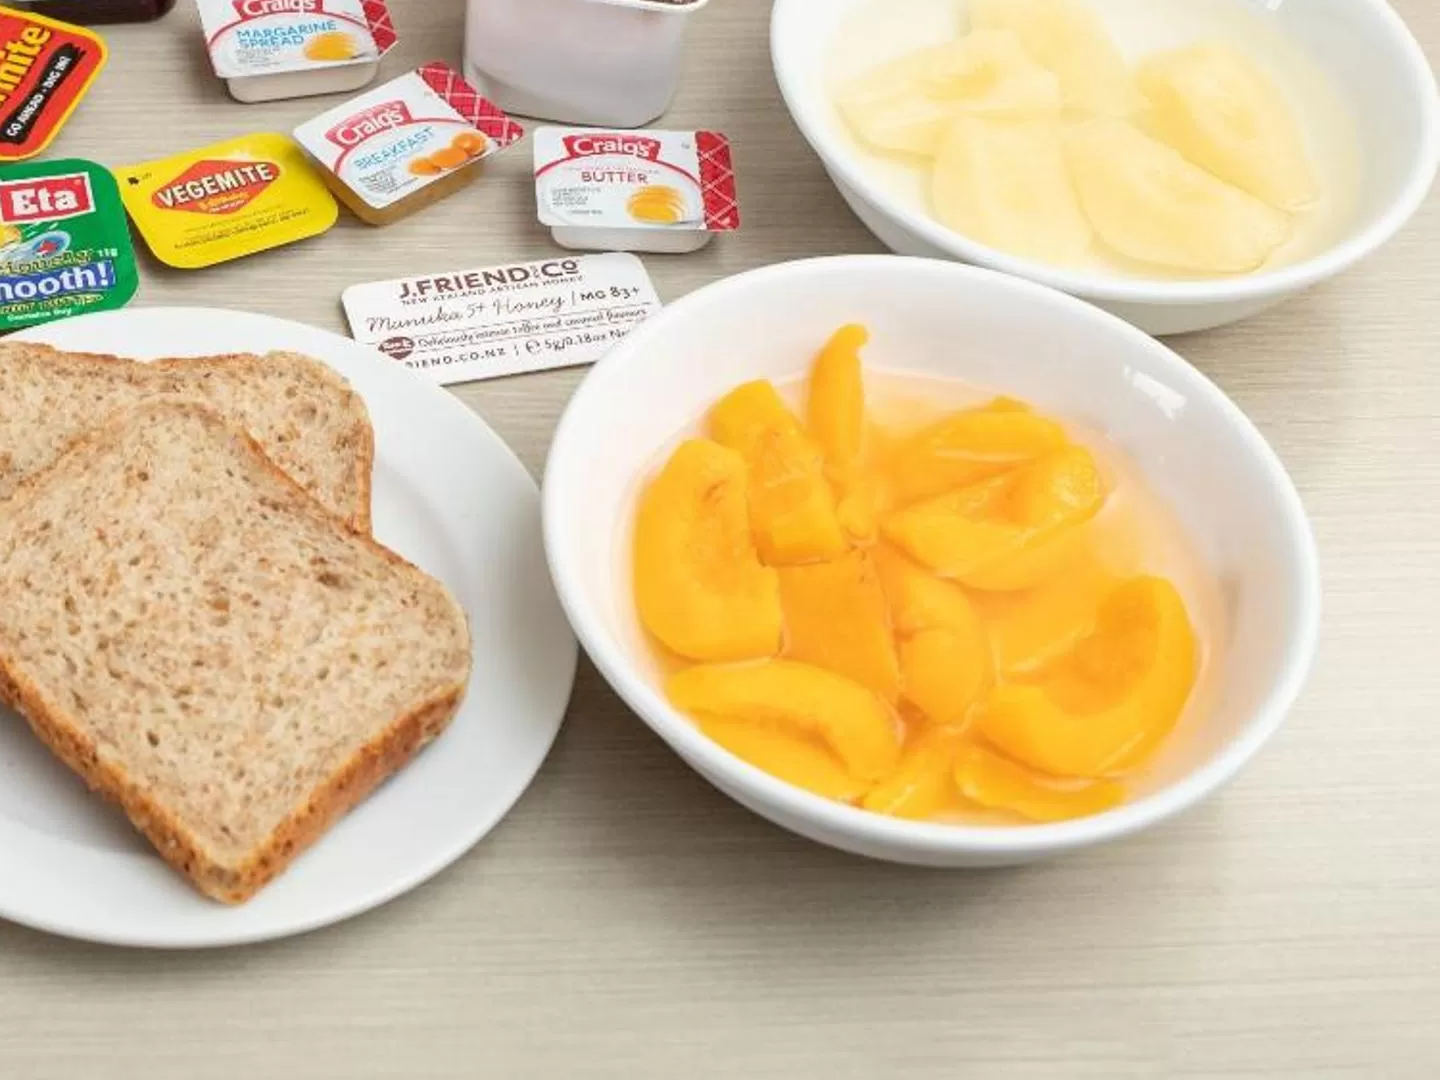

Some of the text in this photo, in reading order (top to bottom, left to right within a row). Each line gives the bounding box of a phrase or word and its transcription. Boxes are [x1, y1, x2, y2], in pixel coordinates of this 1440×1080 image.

[236, 20, 338, 38] MARGARINE
[238, 34, 305, 49] SPREAD
[6, 122, 23, 136] GO
[17, 93, 45, 124] AHEAD
[42, 70, 61, 88] DIG
[336, 104, 406, 146] Craig's
[354, 126, 436, 171] BREAKFAST
[573, 138, 655, 158] Craig's
[157, 163, 274, 208] VEGEMITE
[581, 171, 650, 184] BUTTER
[11, 187, 79, 216] Eta
[399, 265, 530, 299] J.FRIEND
[402, 275, 585, 306] NEW ZEALAND ARTISAN HONEY
[366, 308, 464, 334] Manuka
[466, 304, 486, 318] 5+
[492, 294, 568, 317] Honey
[580, 289, 607, 301] MG
